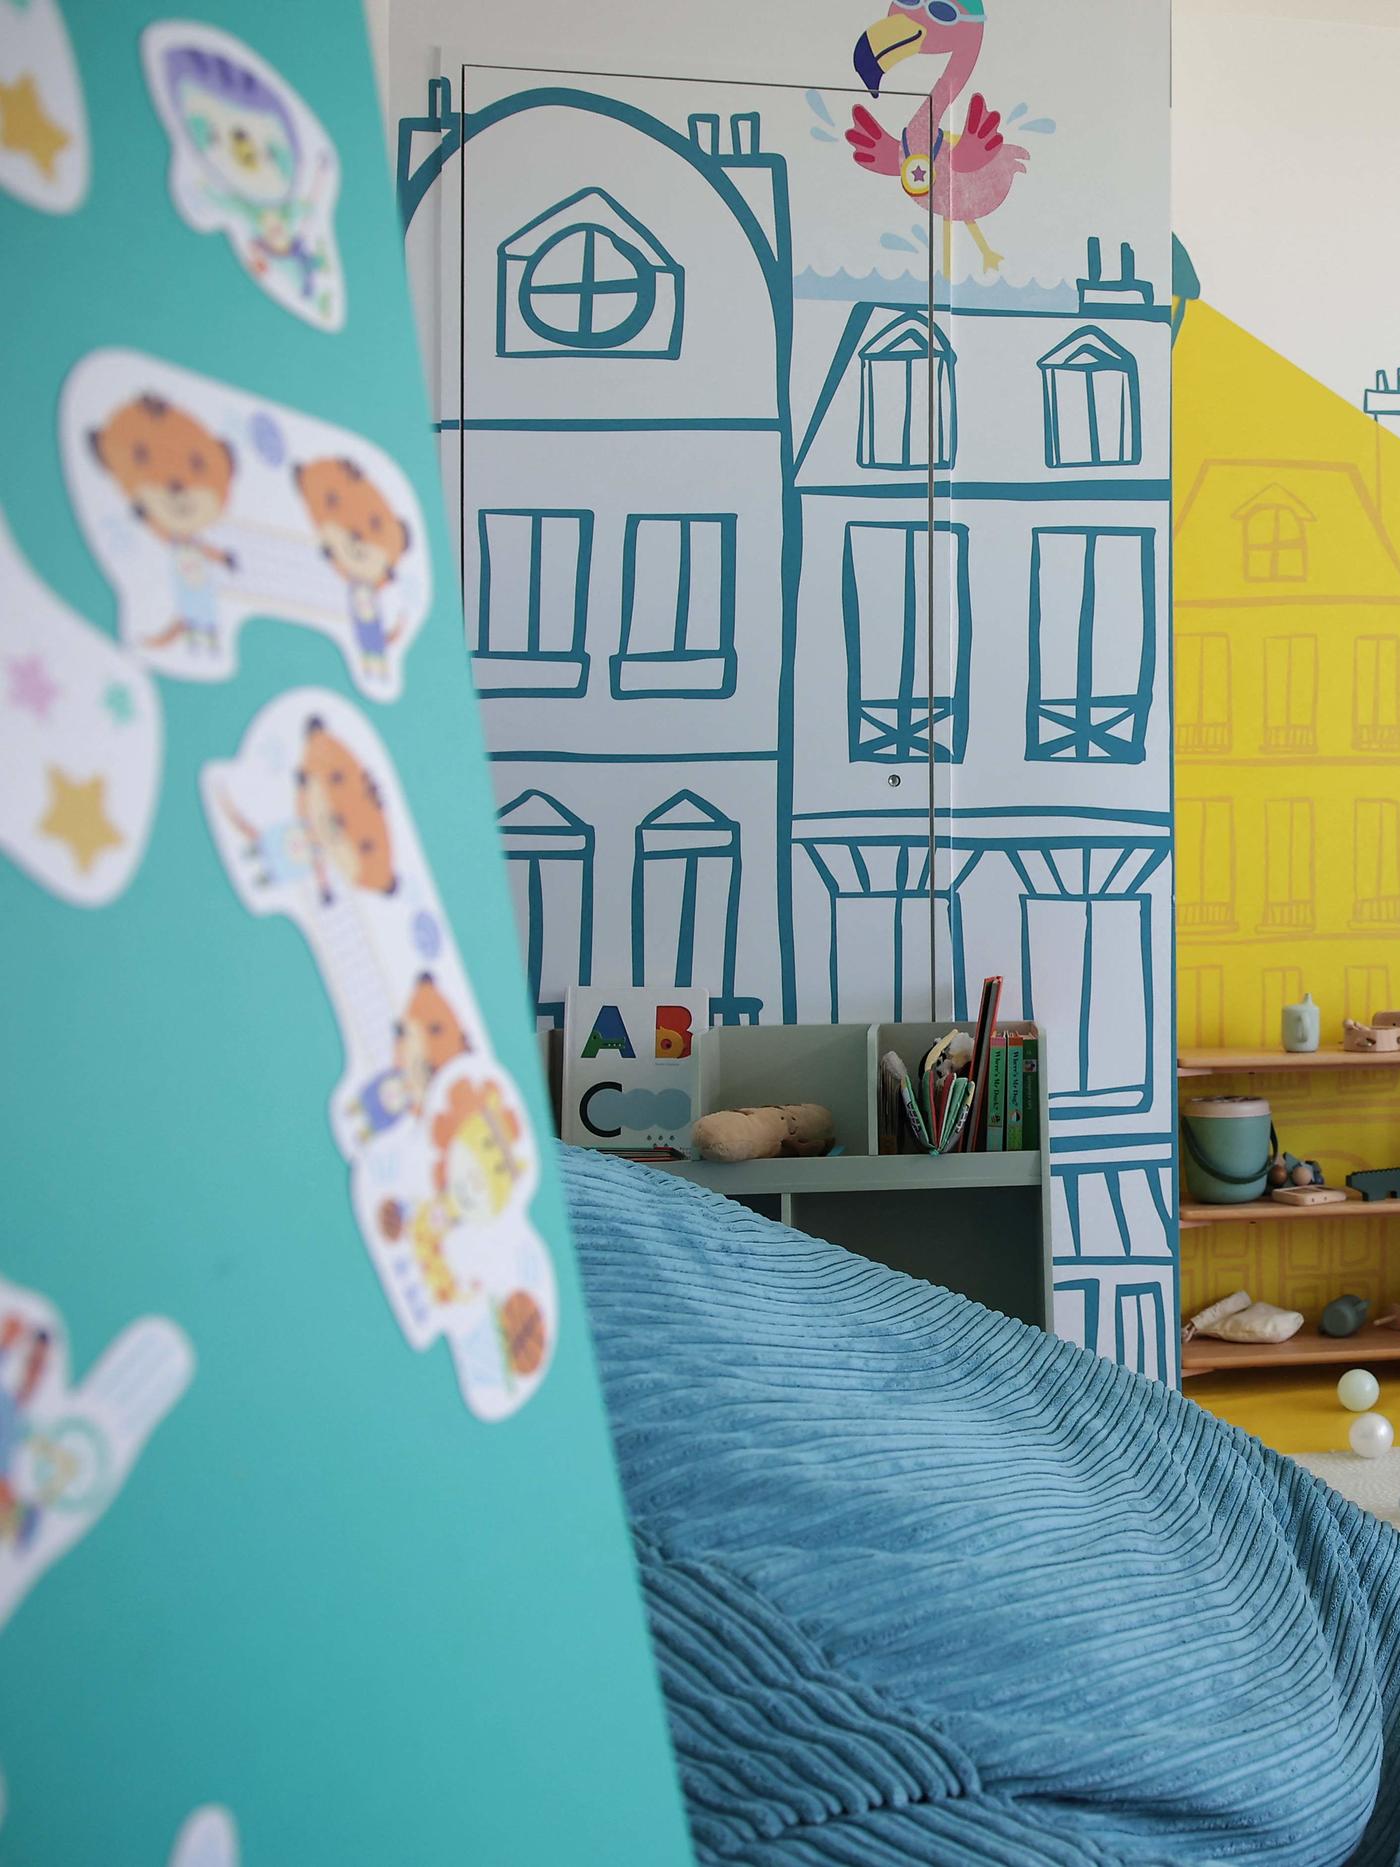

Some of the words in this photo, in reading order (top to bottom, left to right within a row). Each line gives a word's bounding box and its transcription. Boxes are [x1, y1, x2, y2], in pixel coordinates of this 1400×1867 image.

[581, 1006, 636, 1058] A
[656, 1006, 692, 1058] B
[579, 1082, 622, 1137] C
